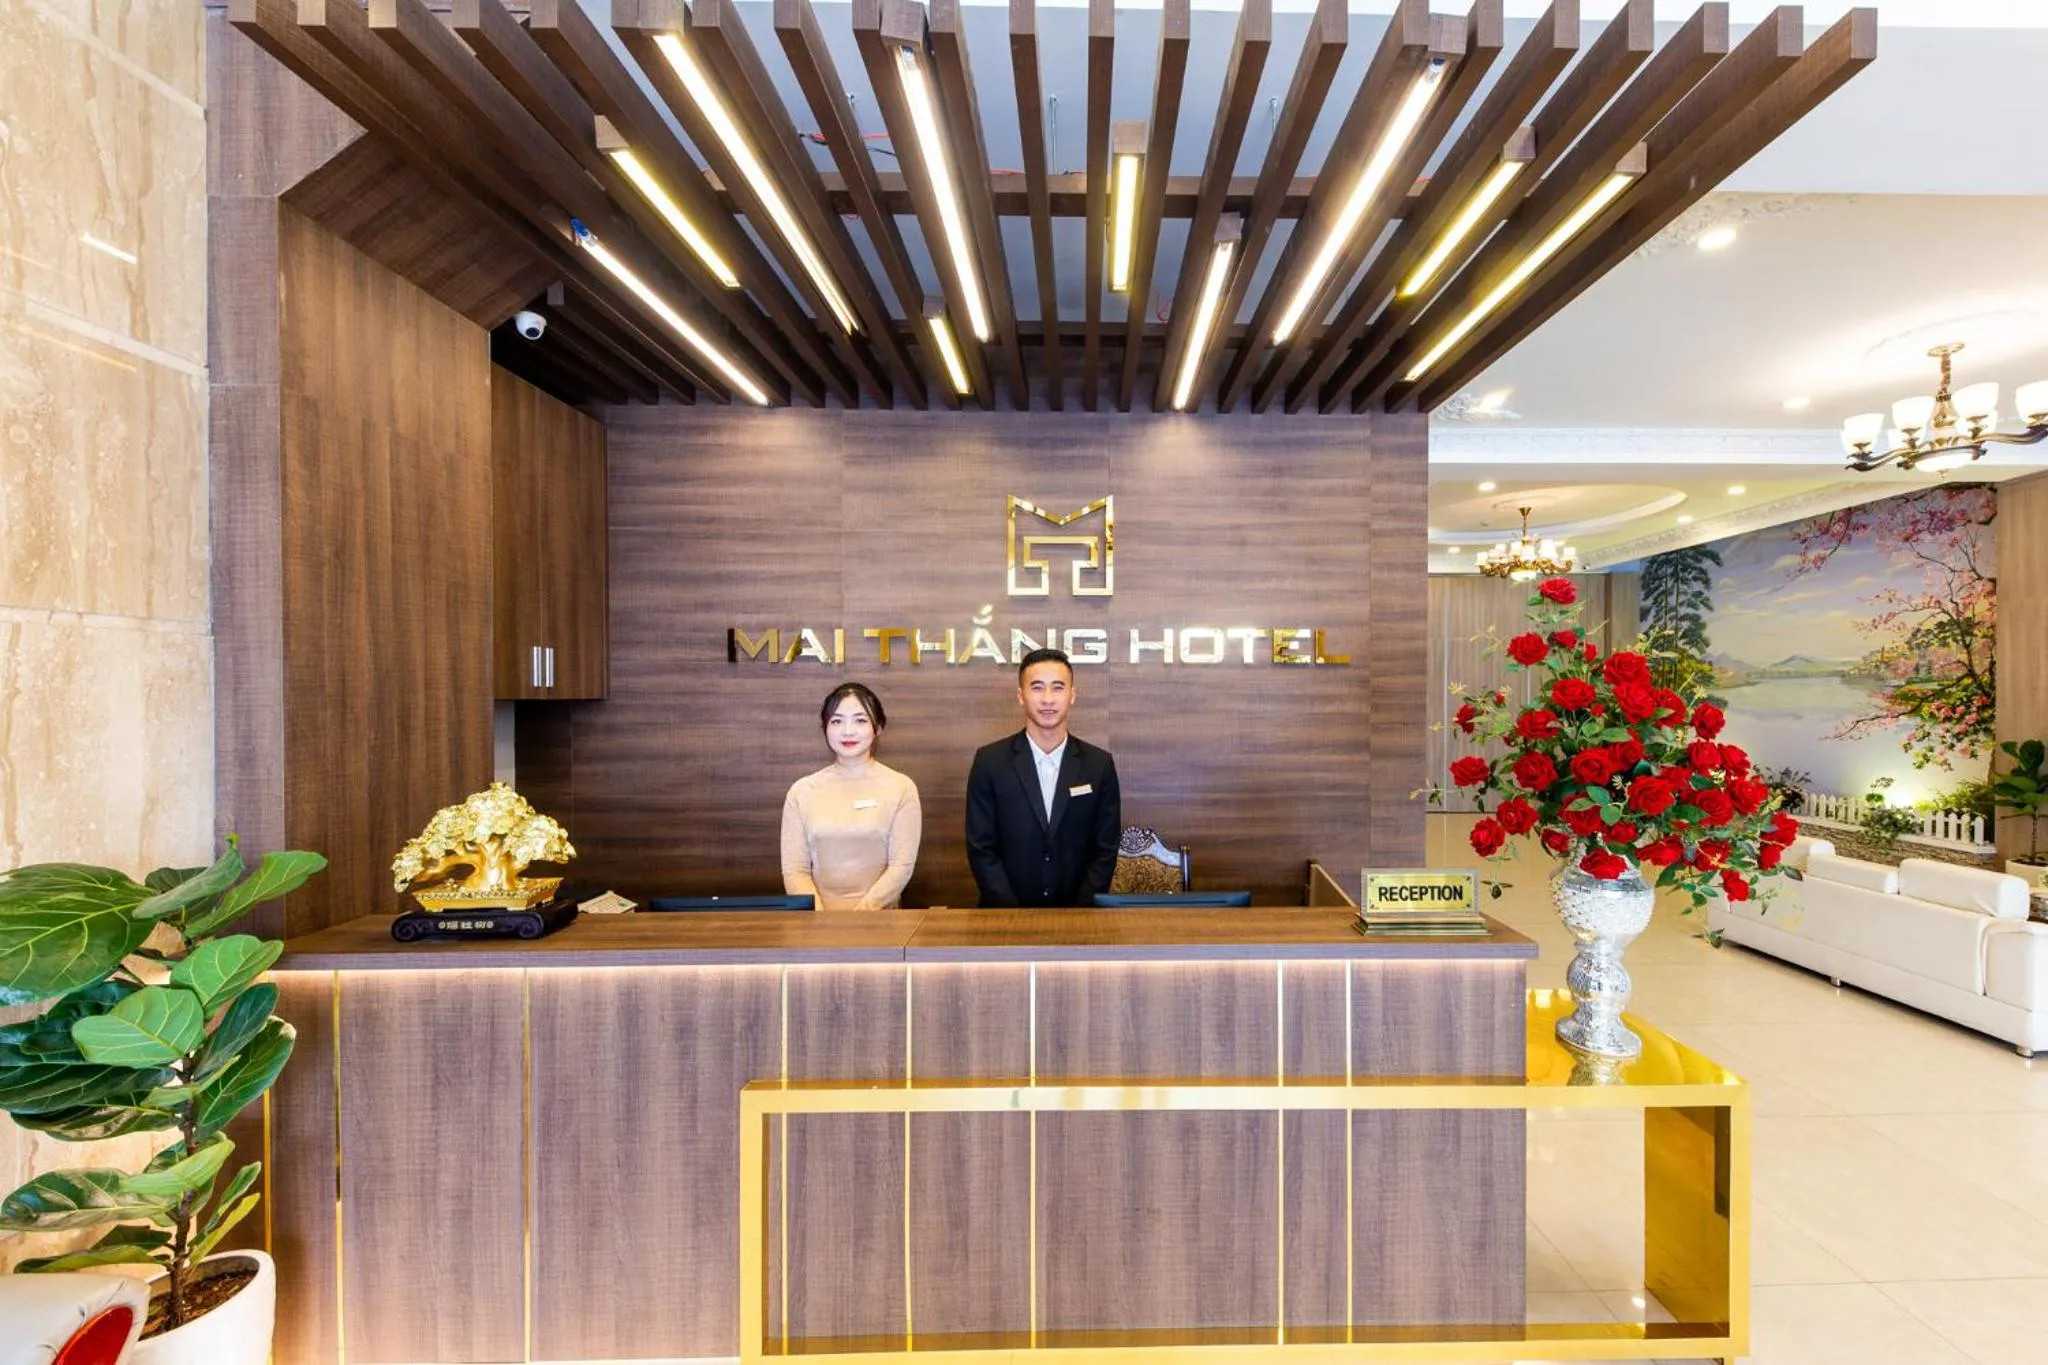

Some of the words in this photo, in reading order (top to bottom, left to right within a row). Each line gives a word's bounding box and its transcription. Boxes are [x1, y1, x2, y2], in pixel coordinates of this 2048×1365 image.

[727, 627, 845, 664] MAI
[863, 604, 1108, 665] THẮNG
[1129, 627, 1352, 664] HOTEL
[1378, 885, 1464, 902] RECEPTION
